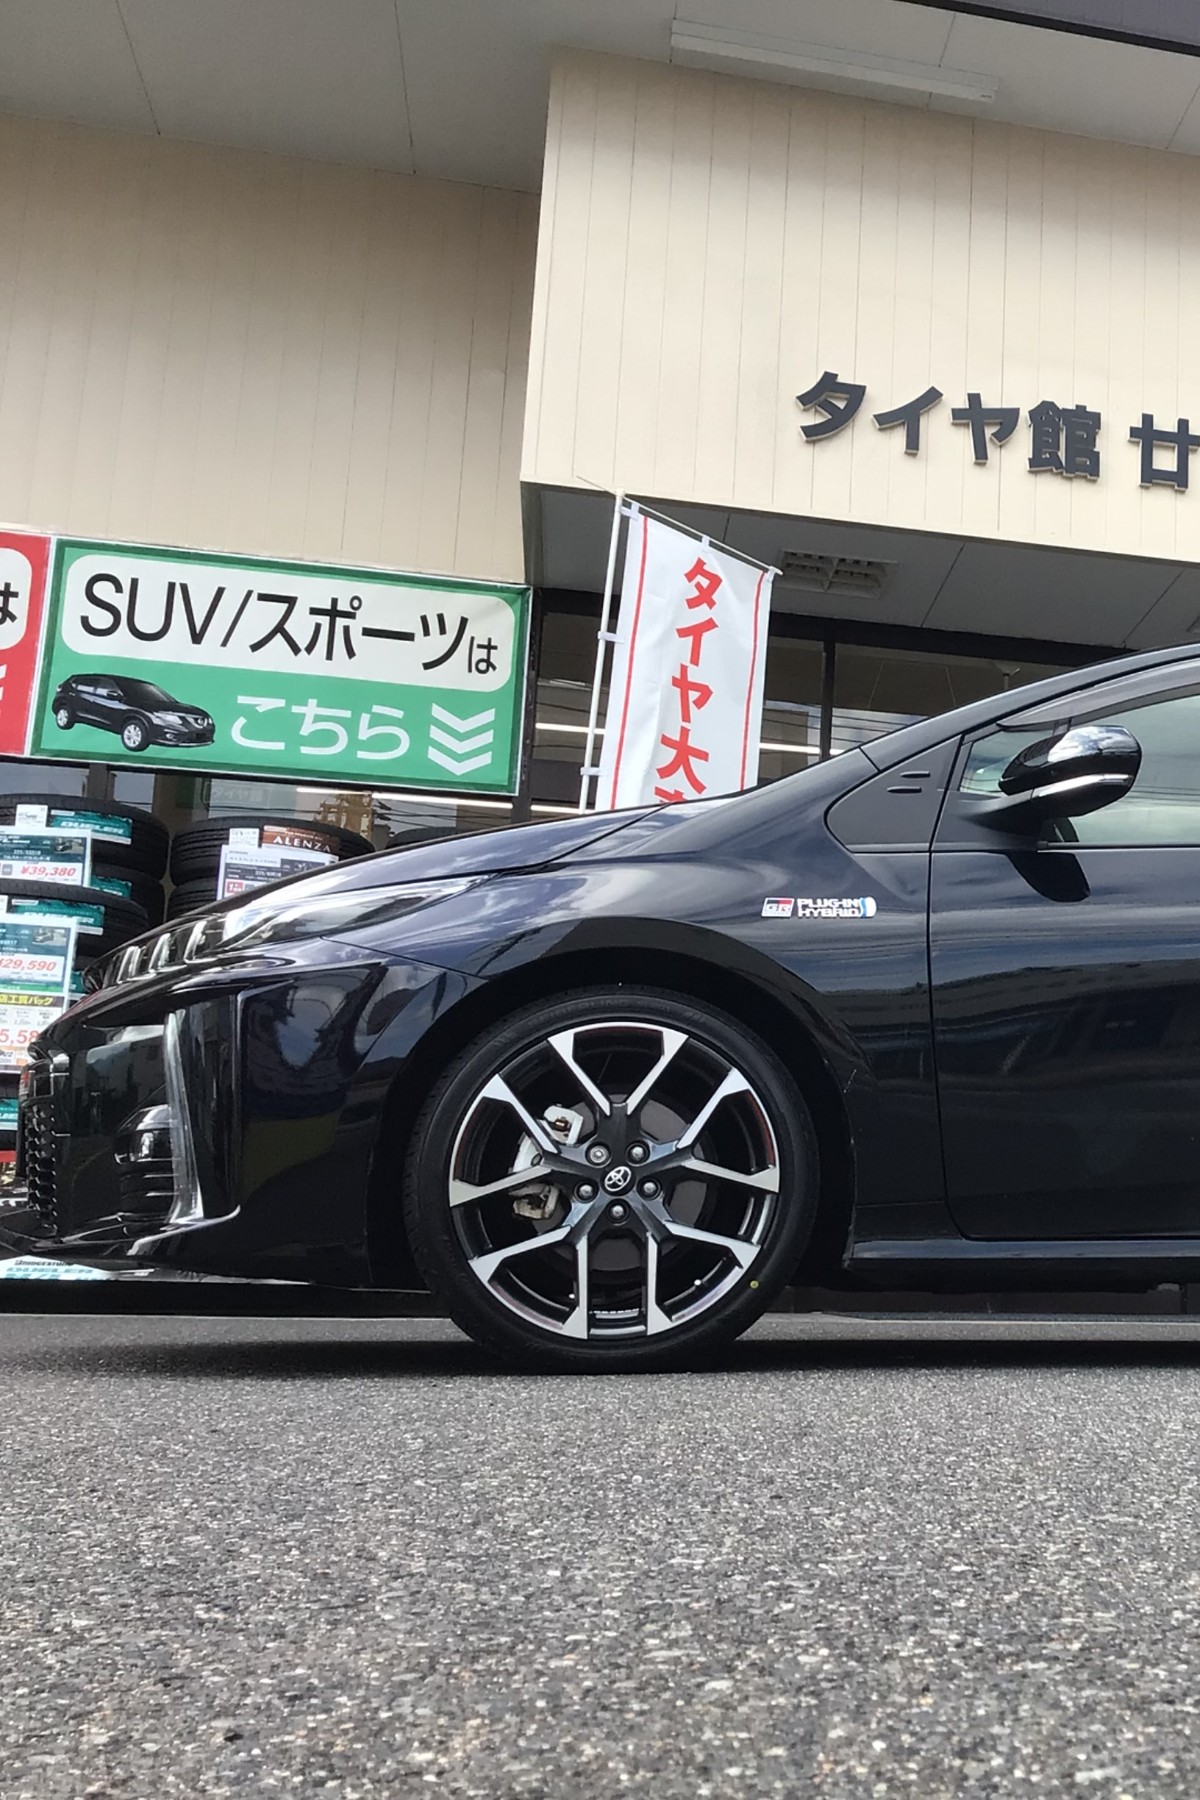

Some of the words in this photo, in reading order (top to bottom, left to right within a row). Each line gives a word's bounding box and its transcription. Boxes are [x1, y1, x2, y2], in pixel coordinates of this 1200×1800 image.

[796, 371, 1101, 480] タイヤ館
[655, 557, 722, 803] タイヤ大
[230, 694, 411, 761] こちら
[273, 836, 331, 853] ALENZA
[797, 908, 861, 918] HYBRID
